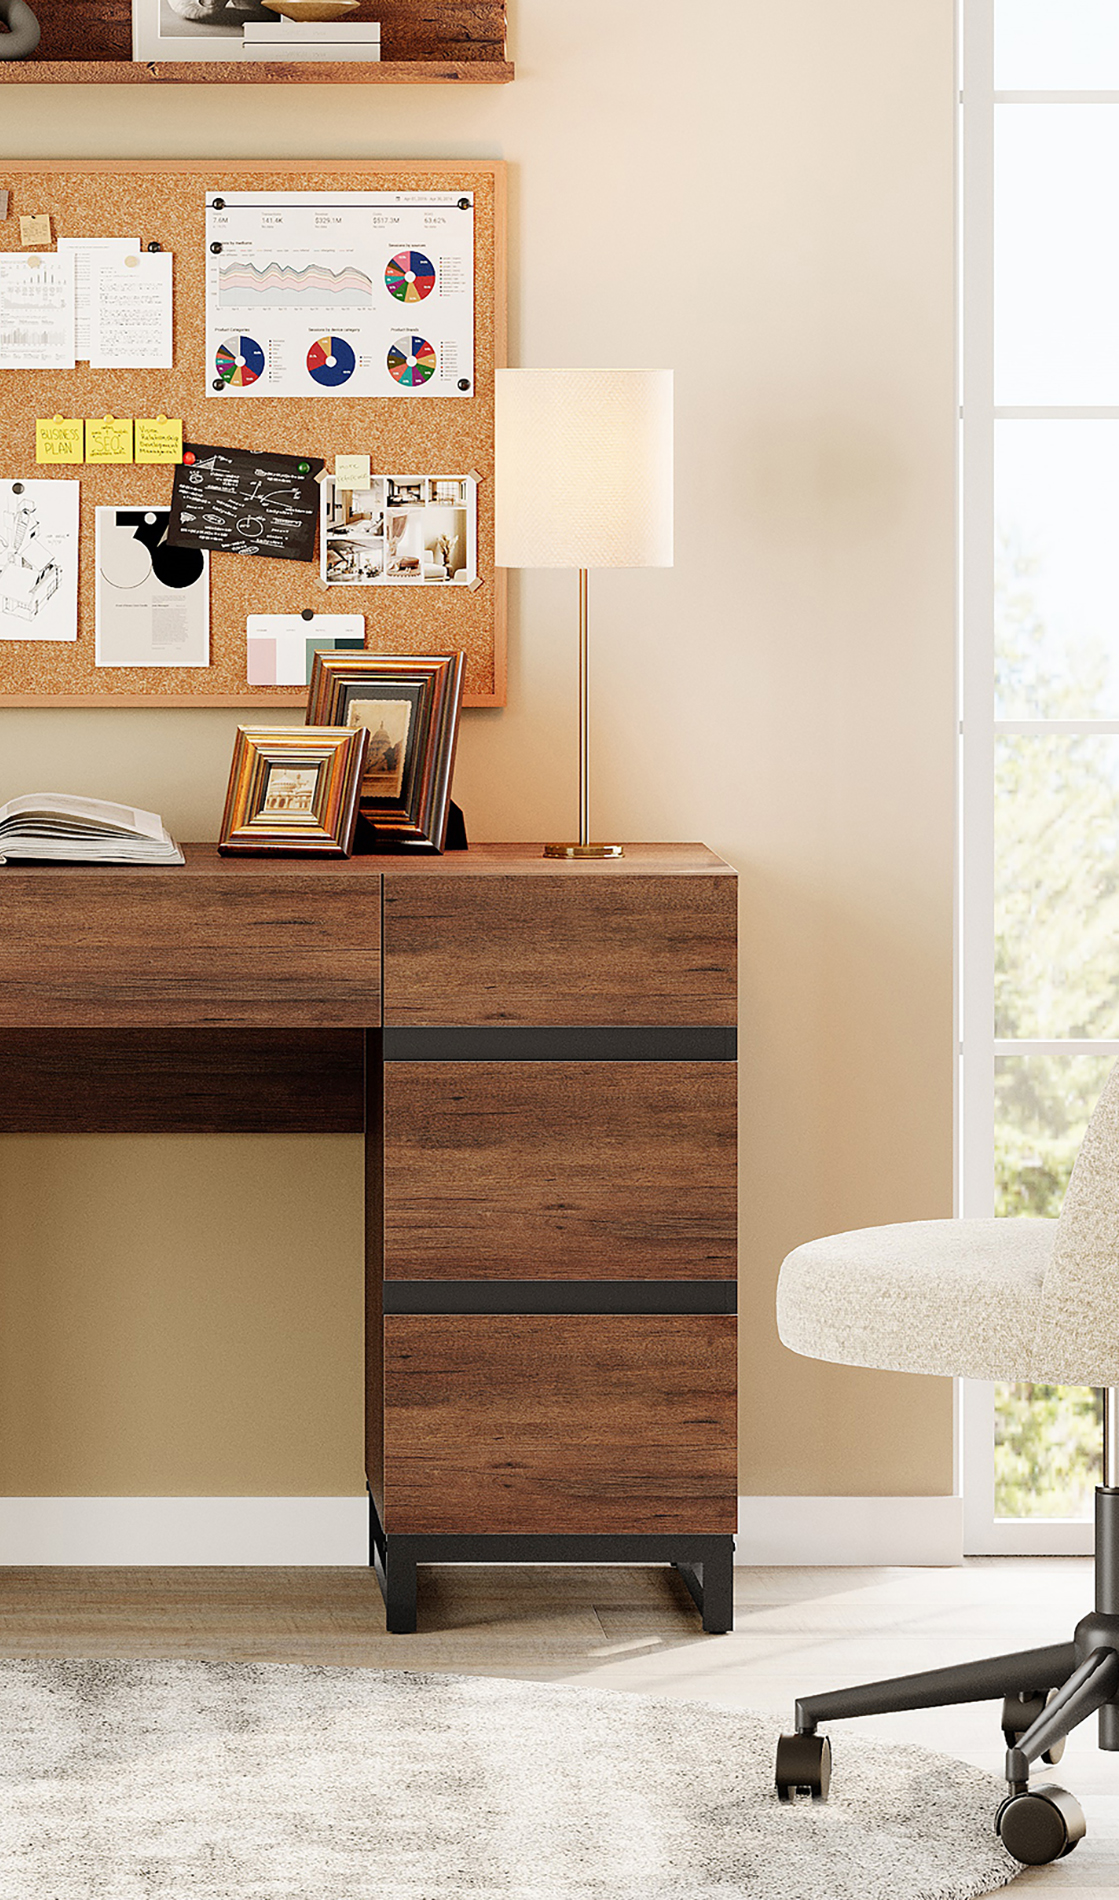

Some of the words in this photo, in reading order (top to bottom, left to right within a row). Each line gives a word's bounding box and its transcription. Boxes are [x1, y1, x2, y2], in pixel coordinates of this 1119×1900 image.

[40, 428, 80, 441] BUSINESS
[44, 442, 73, 455] PLAN
[94, 435, 121, 452] SEO
